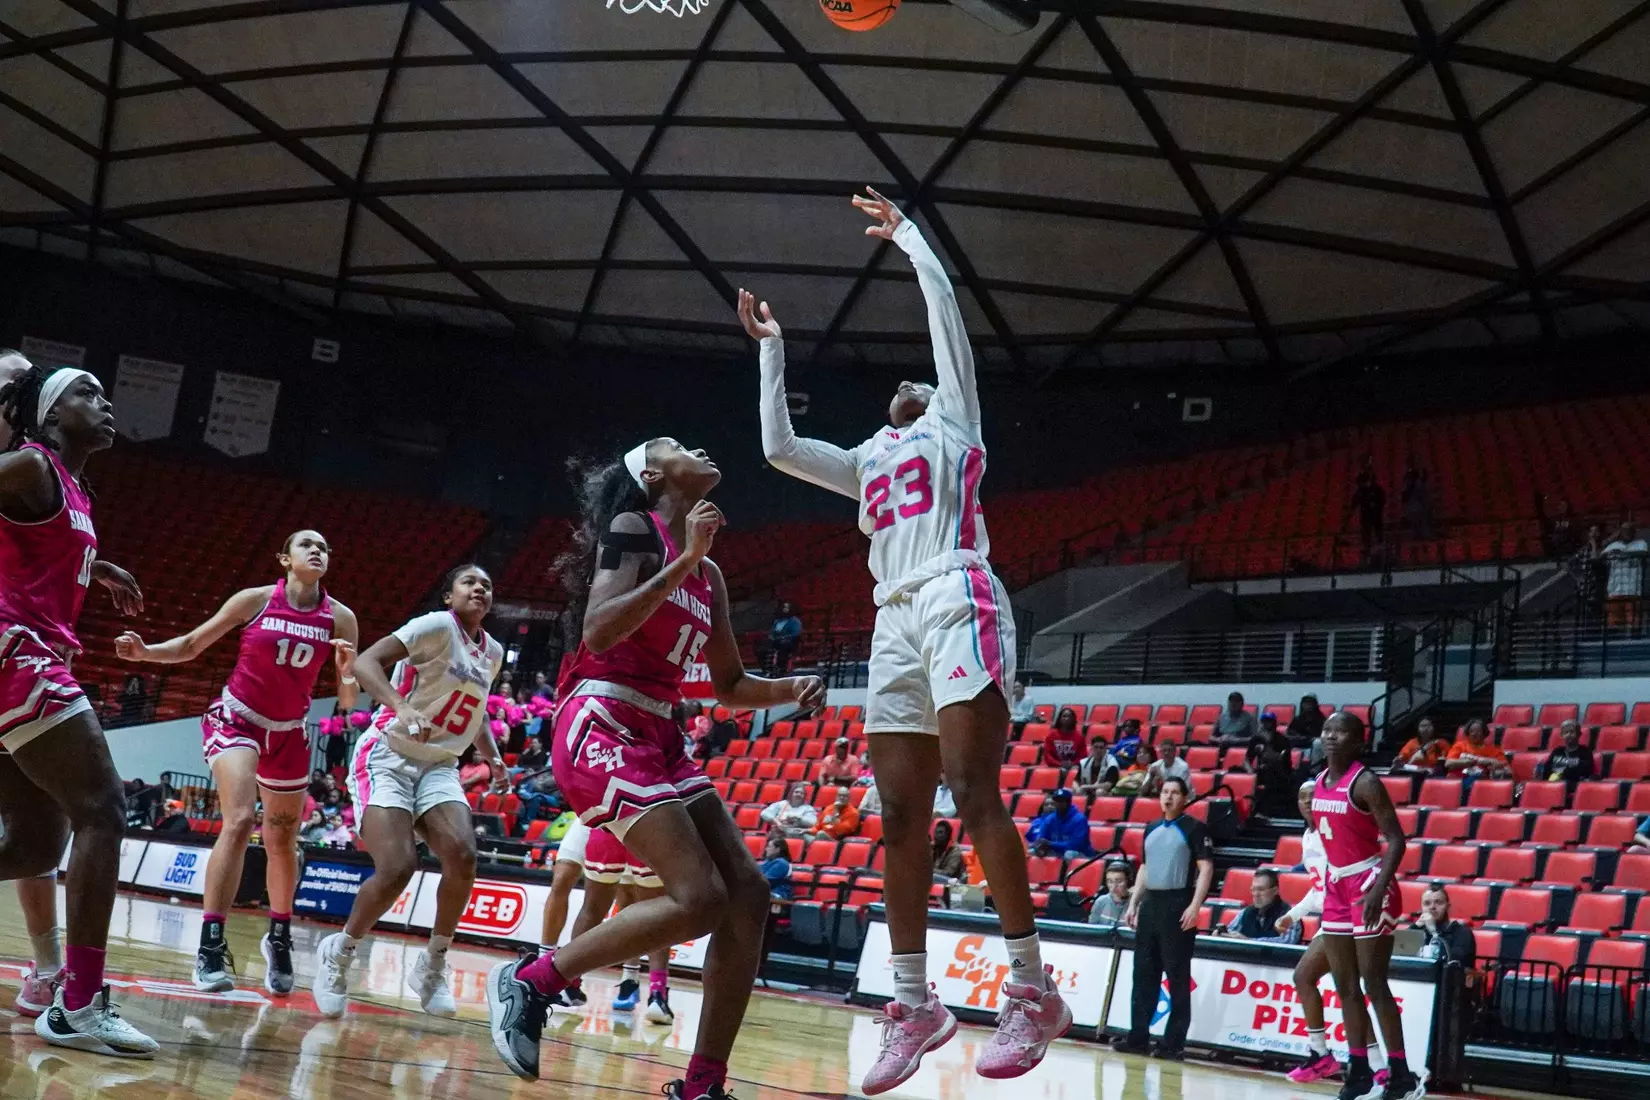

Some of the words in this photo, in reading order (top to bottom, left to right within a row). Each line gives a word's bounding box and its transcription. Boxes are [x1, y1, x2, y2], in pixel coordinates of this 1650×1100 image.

[312, 338, 340, 363] B
[1183, 398, 1212, 421] D
[864, 455, 934, 532] 23
[260, 616, 286, 633] SAM
[286, 621, 332, 644] HOUSTON
[275, 638, 315, 668] 10
[431, 689, 481, 736] 15
[1319, 816, 1333, 840] 4
[174, 852, 198, 868] BUD
[164, 868, 197, 885] LIGHT
[1228, 1032, 1256, 1044] Order
[1259, 1036, 1291, 1050] Online
